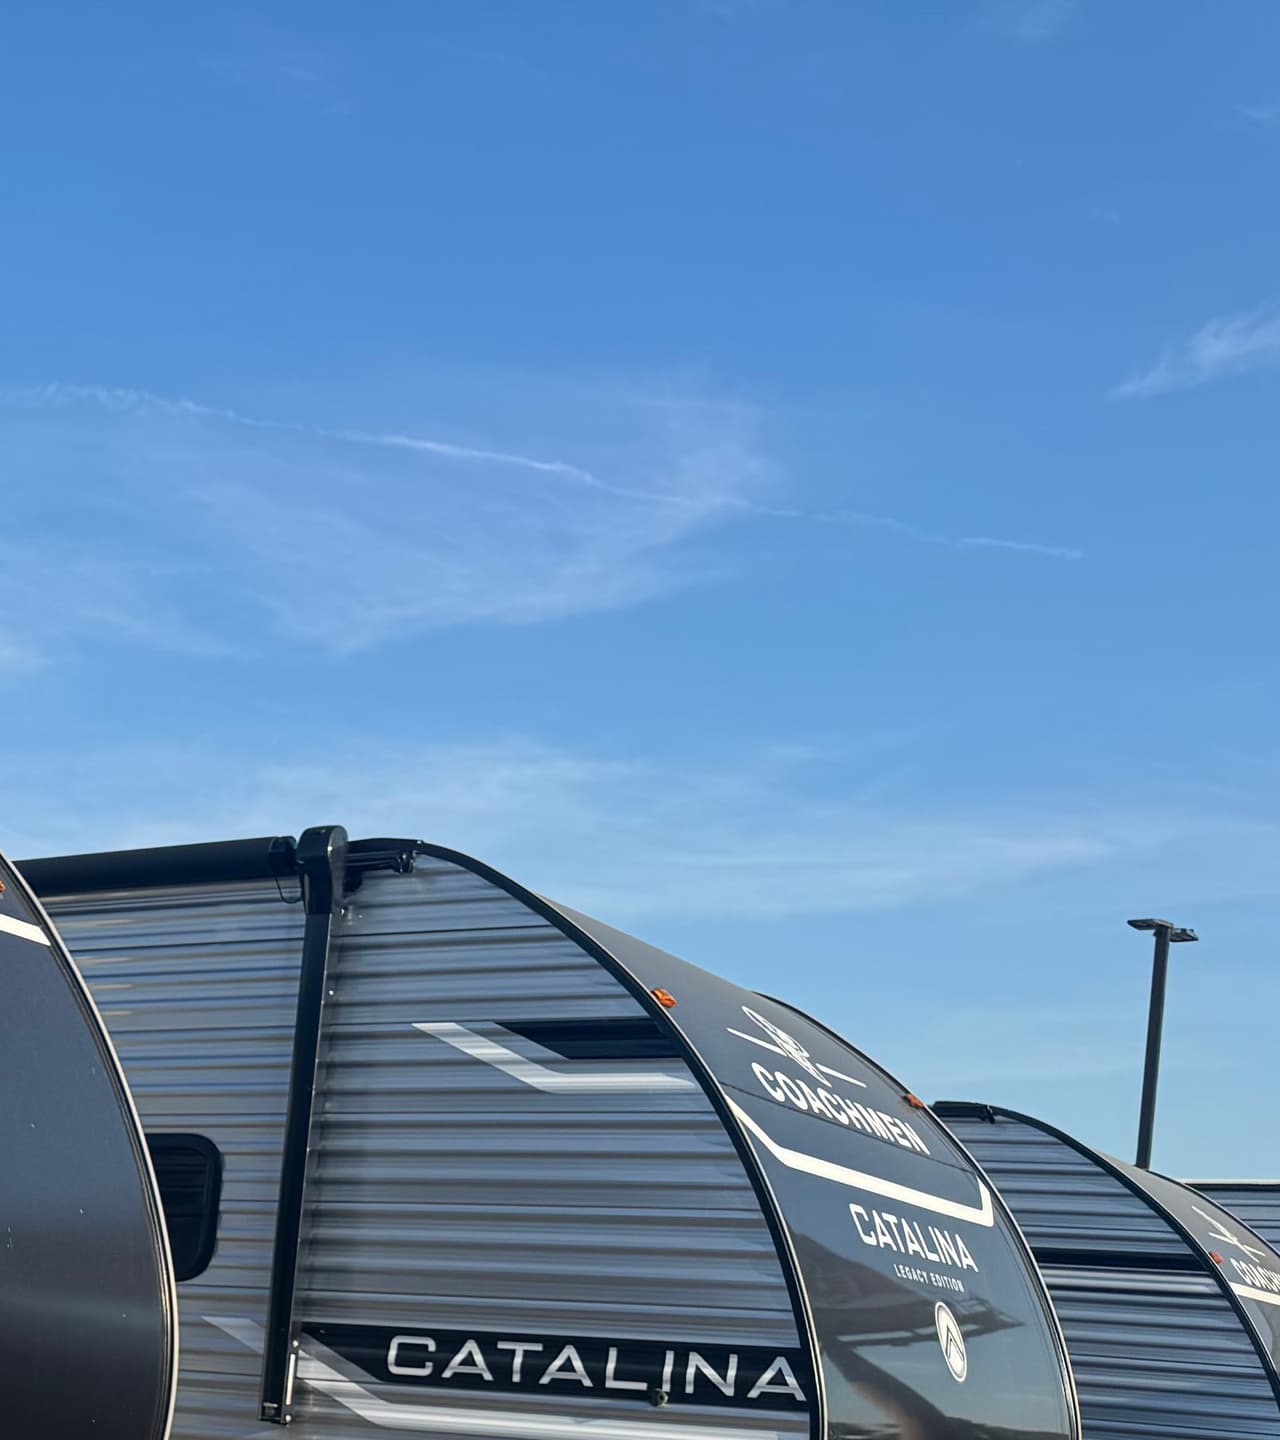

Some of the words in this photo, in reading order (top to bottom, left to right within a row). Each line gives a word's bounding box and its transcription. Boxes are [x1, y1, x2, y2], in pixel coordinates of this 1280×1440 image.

[751, 1062, 931, 1155] COACHMEN
[849, 1203, 979, 1273] CATALINA
[893, 1263, 929, 1284] LEGACY
[929, 1272, 965, 1293] EDITION
[386, 1335, 807, 1401] CATALINA
